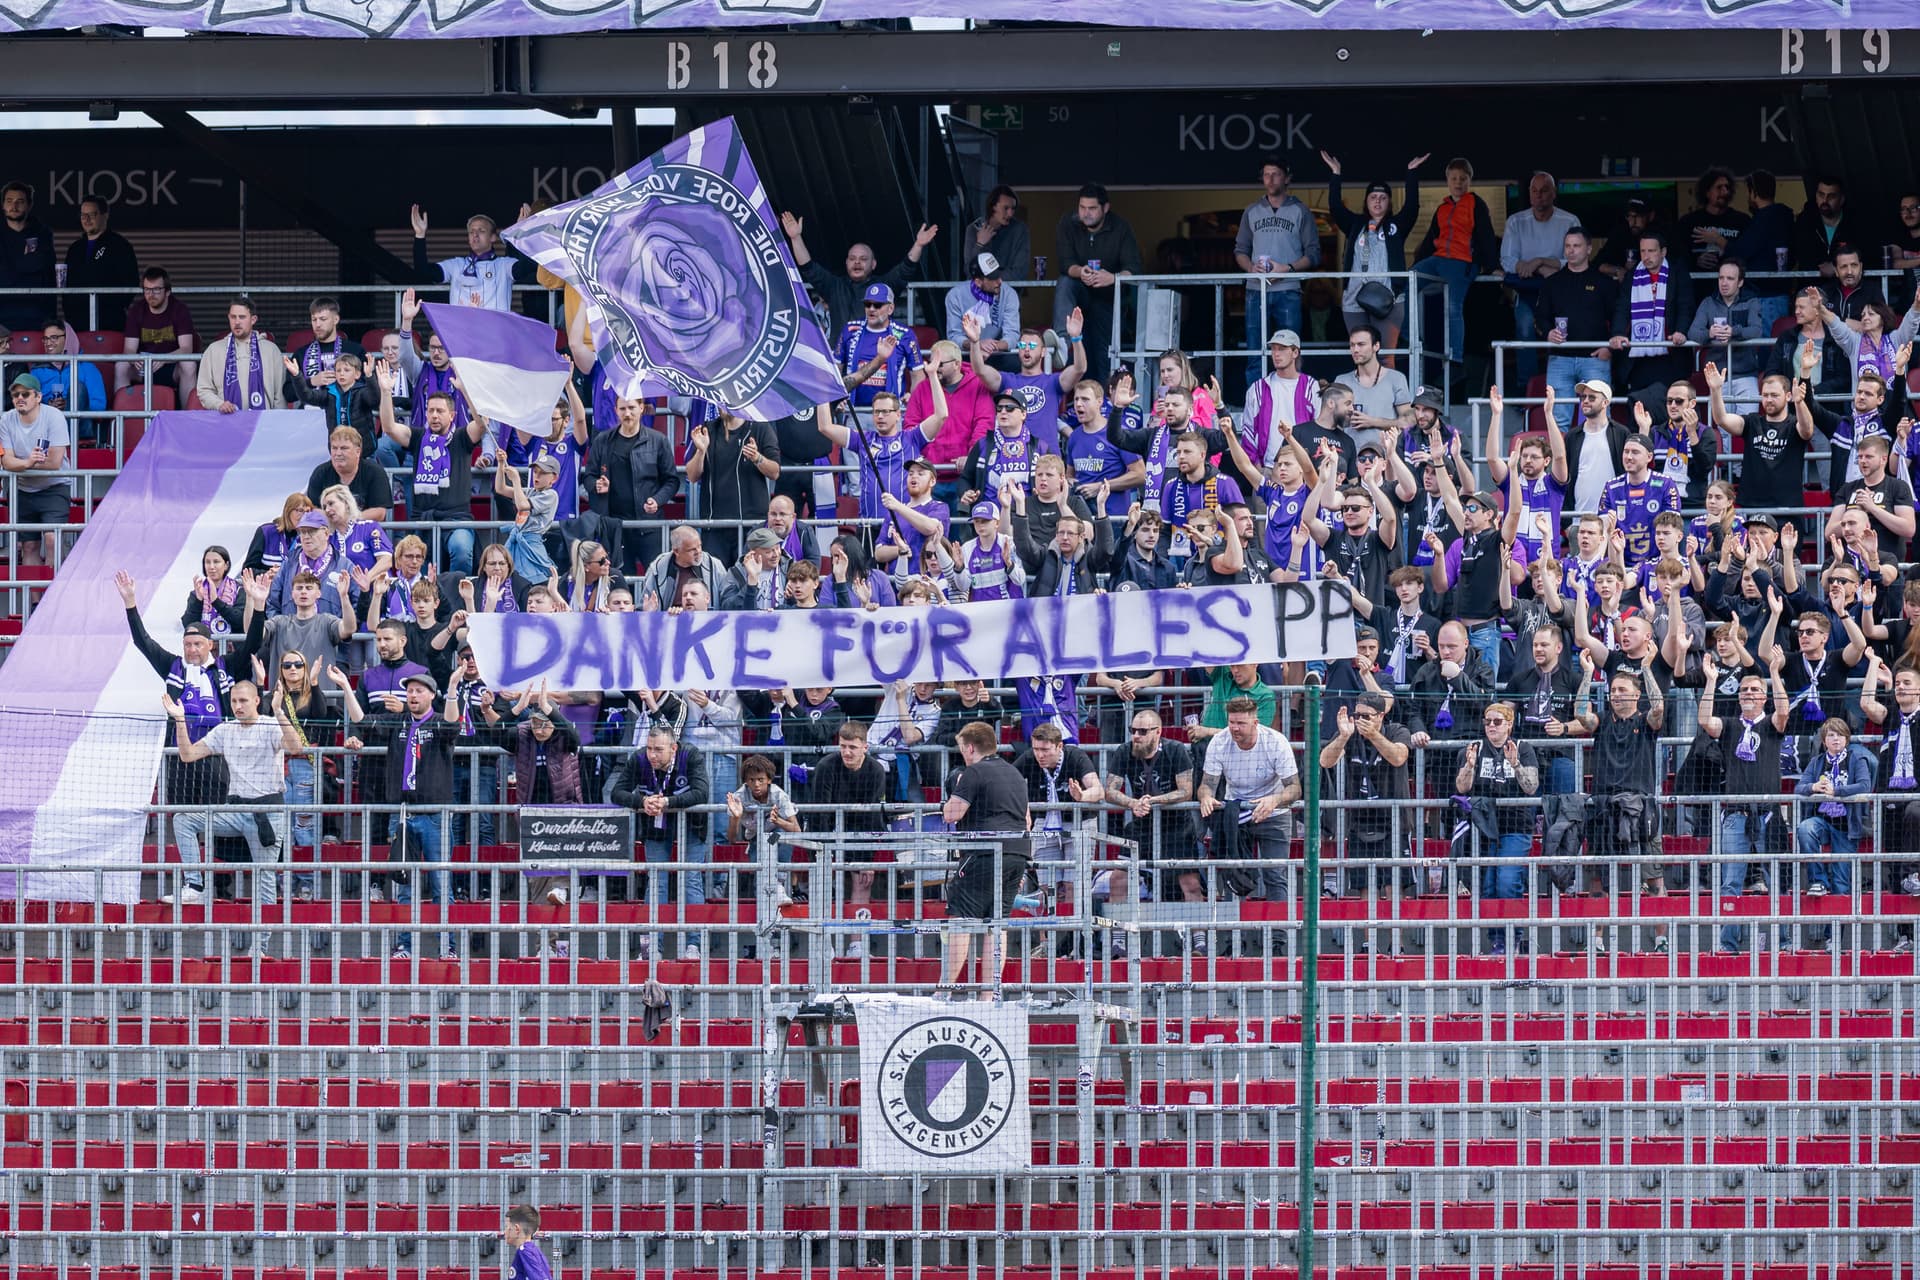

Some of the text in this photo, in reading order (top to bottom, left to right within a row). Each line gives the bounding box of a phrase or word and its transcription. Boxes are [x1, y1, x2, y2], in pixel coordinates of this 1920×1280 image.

[1048, 105, 1070, 123] 50
[1179, 113, 1314, 151] KIOSK
[49, 169, 179, 207] KIOSK
[533, 166, 617, 203] KIO
[1254, 217, 1295, 233] KLAGENFURT
[415, 473, 439, 483] 9020
[1003, 462, 1027, 472] 1920
[498, 580, 1354, 690] DANKE FÜR ALLES PP
[530, 818, 619, 836] Durchhalten
[563, 840, 586, 852] und
[926, 1027, 1005, 1083] AUSTRIA
[888, 1096, 1005, 1149] KLAGENFURT
